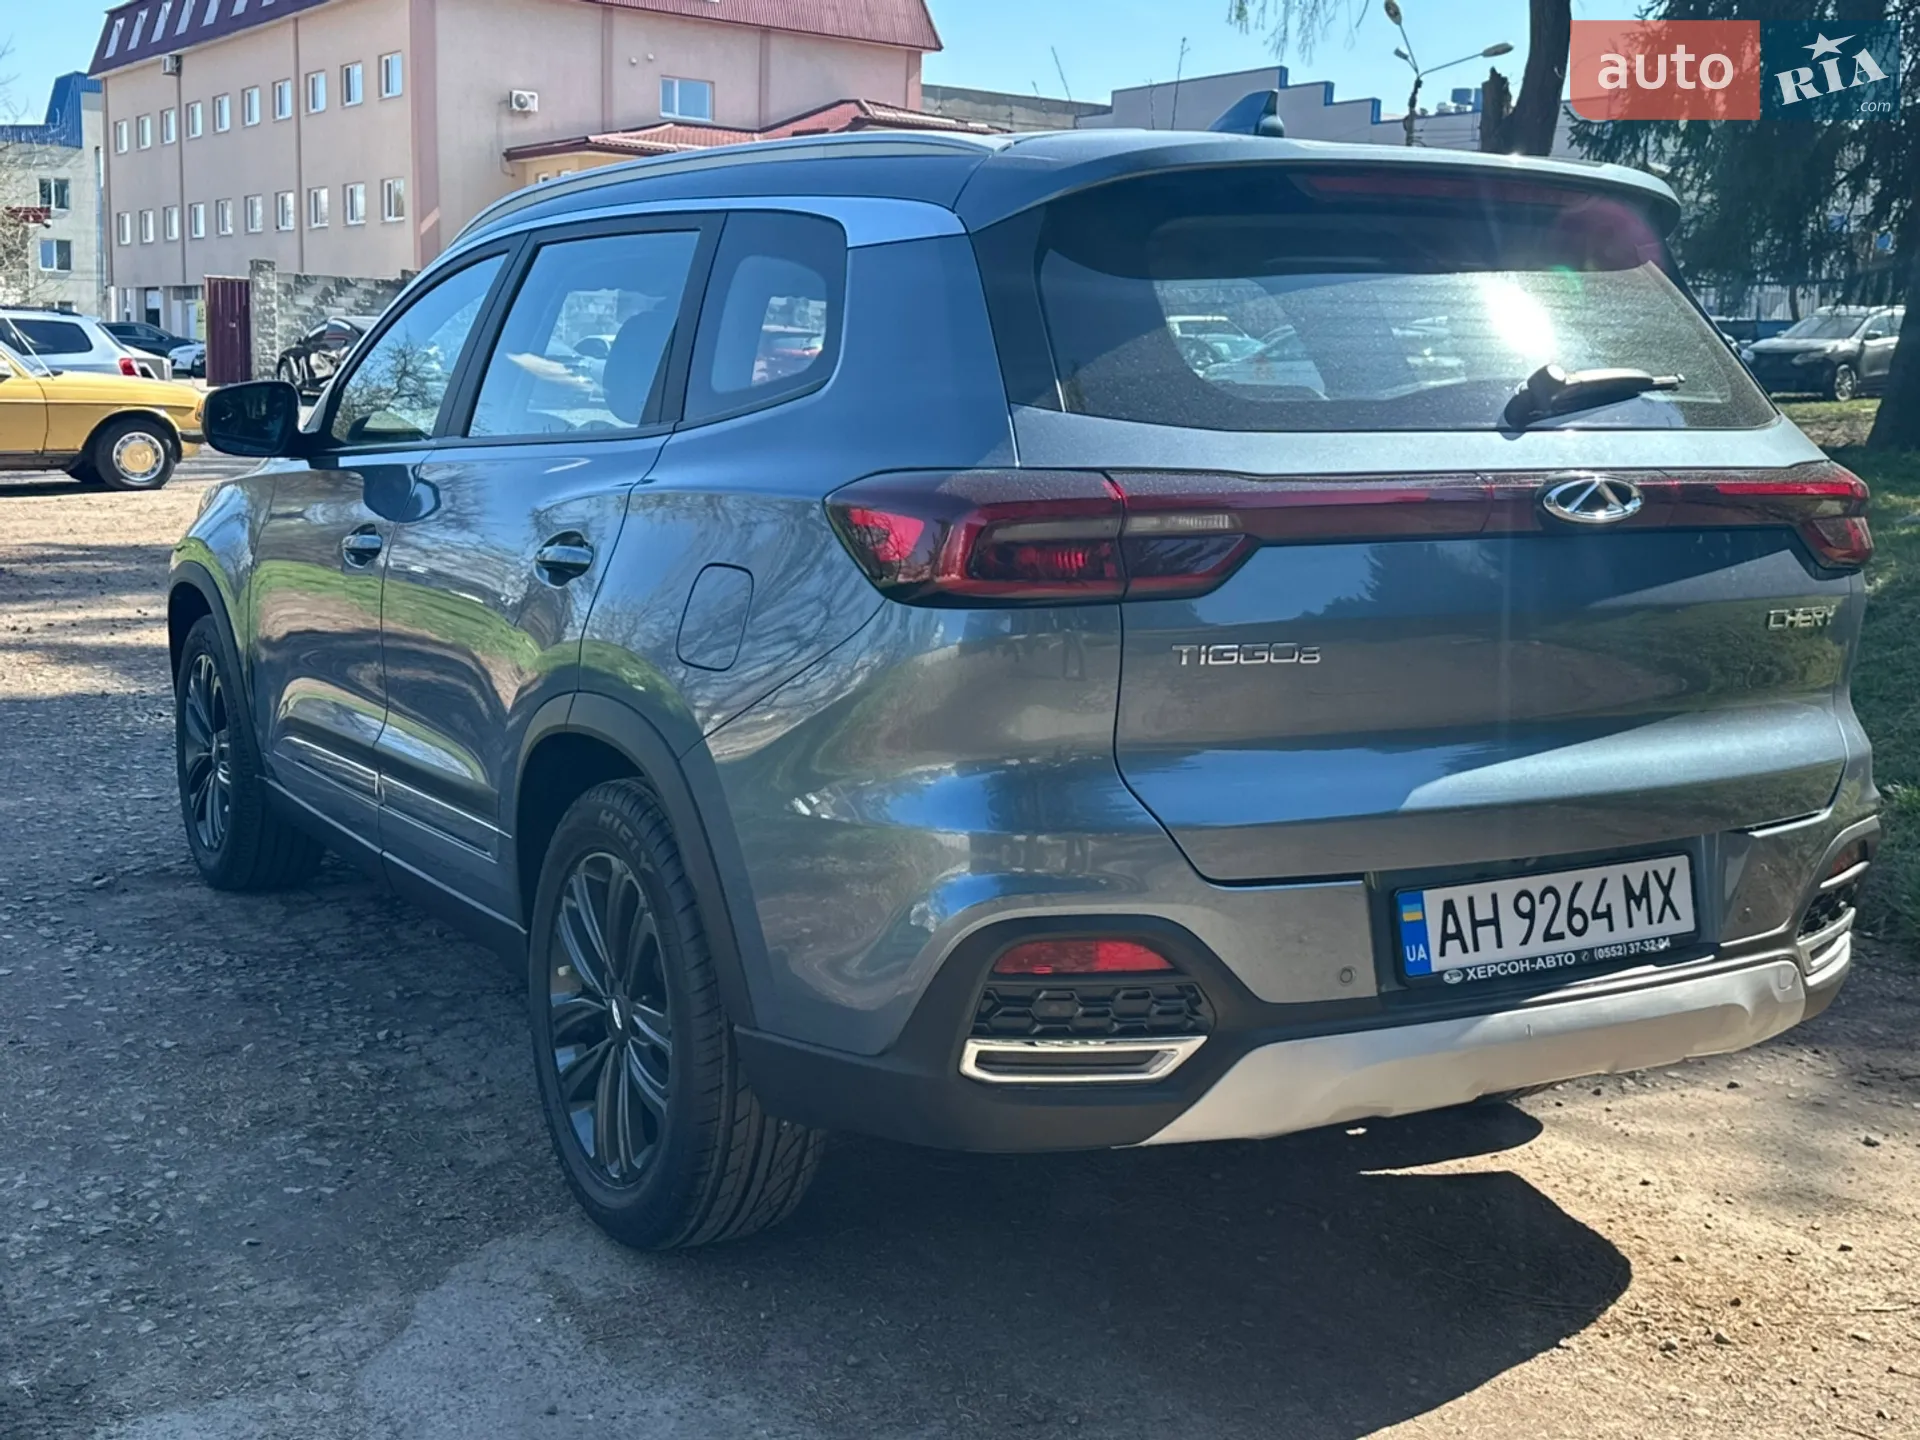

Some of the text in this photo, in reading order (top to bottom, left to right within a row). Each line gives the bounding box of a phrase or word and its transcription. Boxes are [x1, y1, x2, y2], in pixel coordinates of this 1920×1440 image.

[1768, 604, 1836, 631] CHERY
[1438, 867, 1682, 958] AH 9264 MX
[1406, 943, 1428, 962] UA
[1466, 952, 1576, 982] ХЕРСОН-АВТО
[1594, 943, 1628, 960] (0552)
